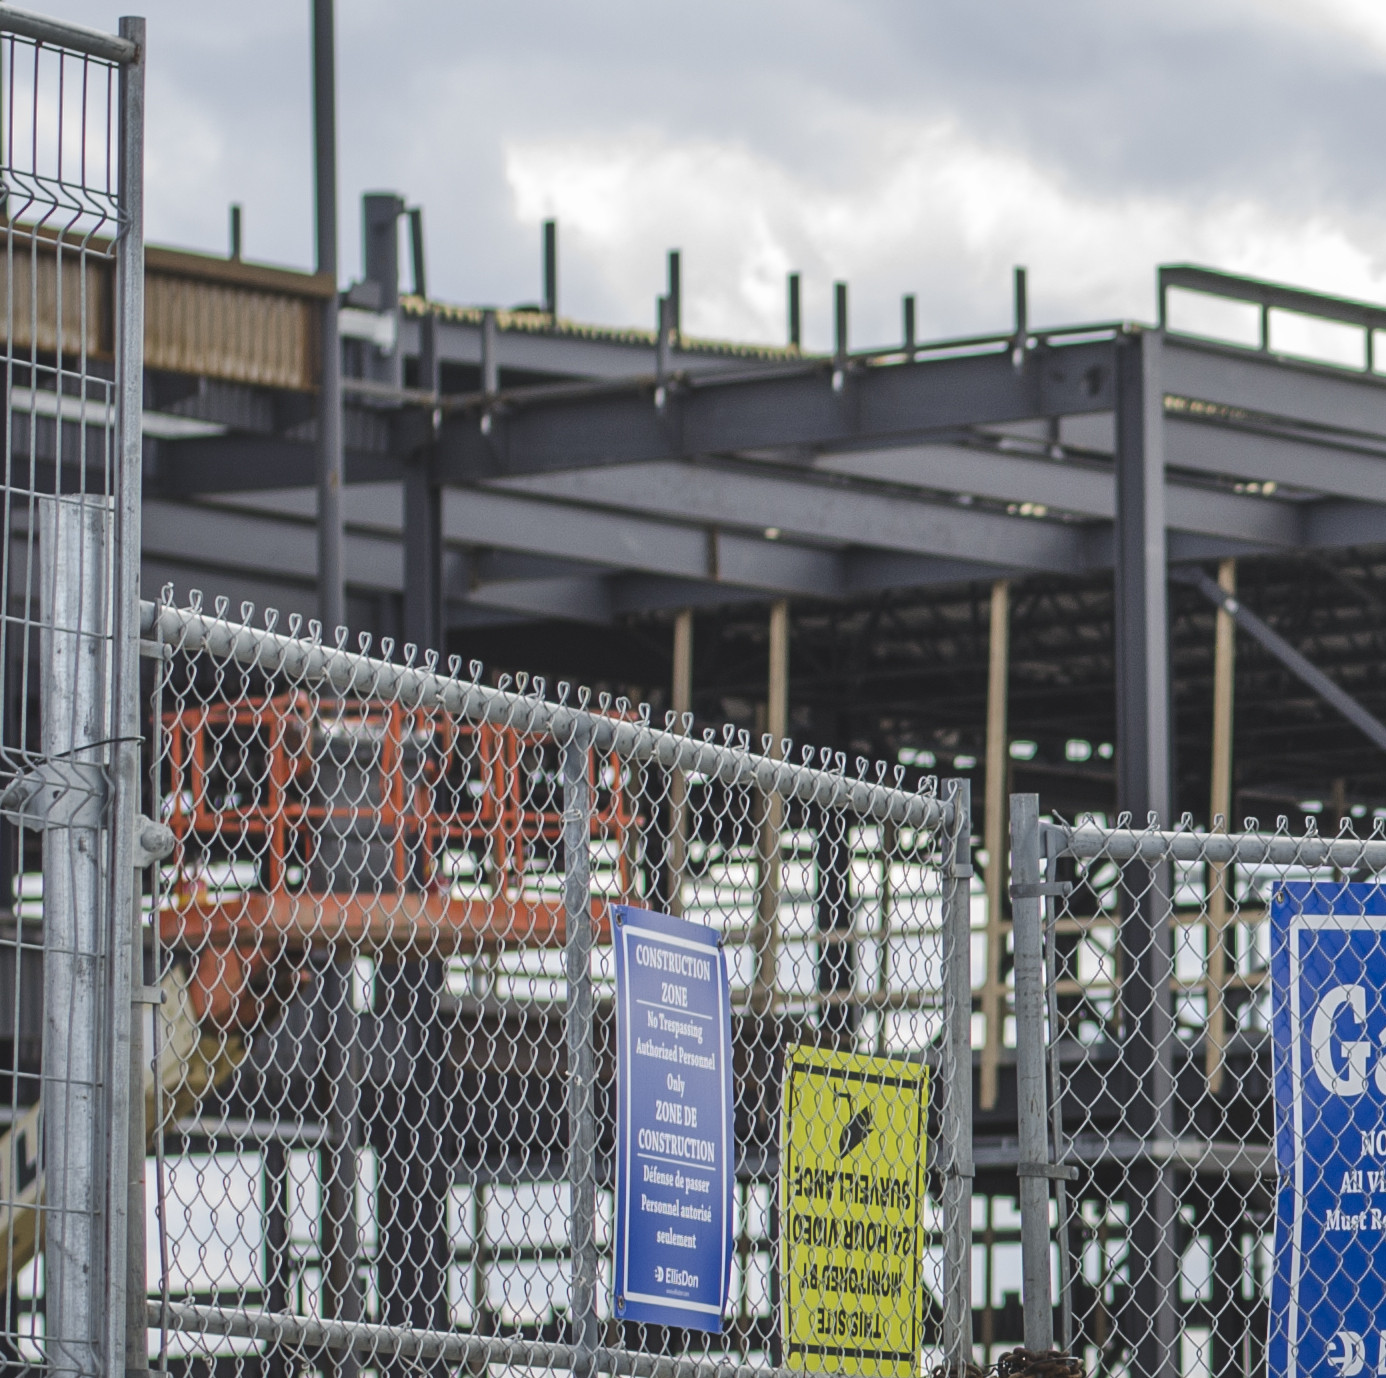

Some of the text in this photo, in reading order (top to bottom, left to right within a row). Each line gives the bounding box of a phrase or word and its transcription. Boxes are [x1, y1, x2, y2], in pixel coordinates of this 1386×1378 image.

[635, 944, 711, 982] CONSTRUCTION
[661, 981, 688, 1008] ZONE
[647, 1010, 703, 1045] No Trespassing
[636, 1037, 716, 1071] Authorized Personnel
[667, 1073, 685, 1098] Only
[656, 1099, 698, 1128] ZONE DE
[638, 1128, 715, 1163] CONSTRUCTION
[643, 1164, 710, 1195] Défense de passer
[794, 1165, 911, 1210] SURVEILLANCE
[1340, 1169, 1363, 1194] All
[641, 1193, 712, 1223] Personnel autorisé
[1325, 1208, 1367, 1231] Must
[656, 1227, 697, 1249] seulement
[793, 1213, 911, 1256] 24 HOUR VIDEO
[665, 1267, 699, 1288] EllisDon
[801, 1262, 903, 1298] MONITORED BY
[817, 1307, 882, 1339] THIS SITE
